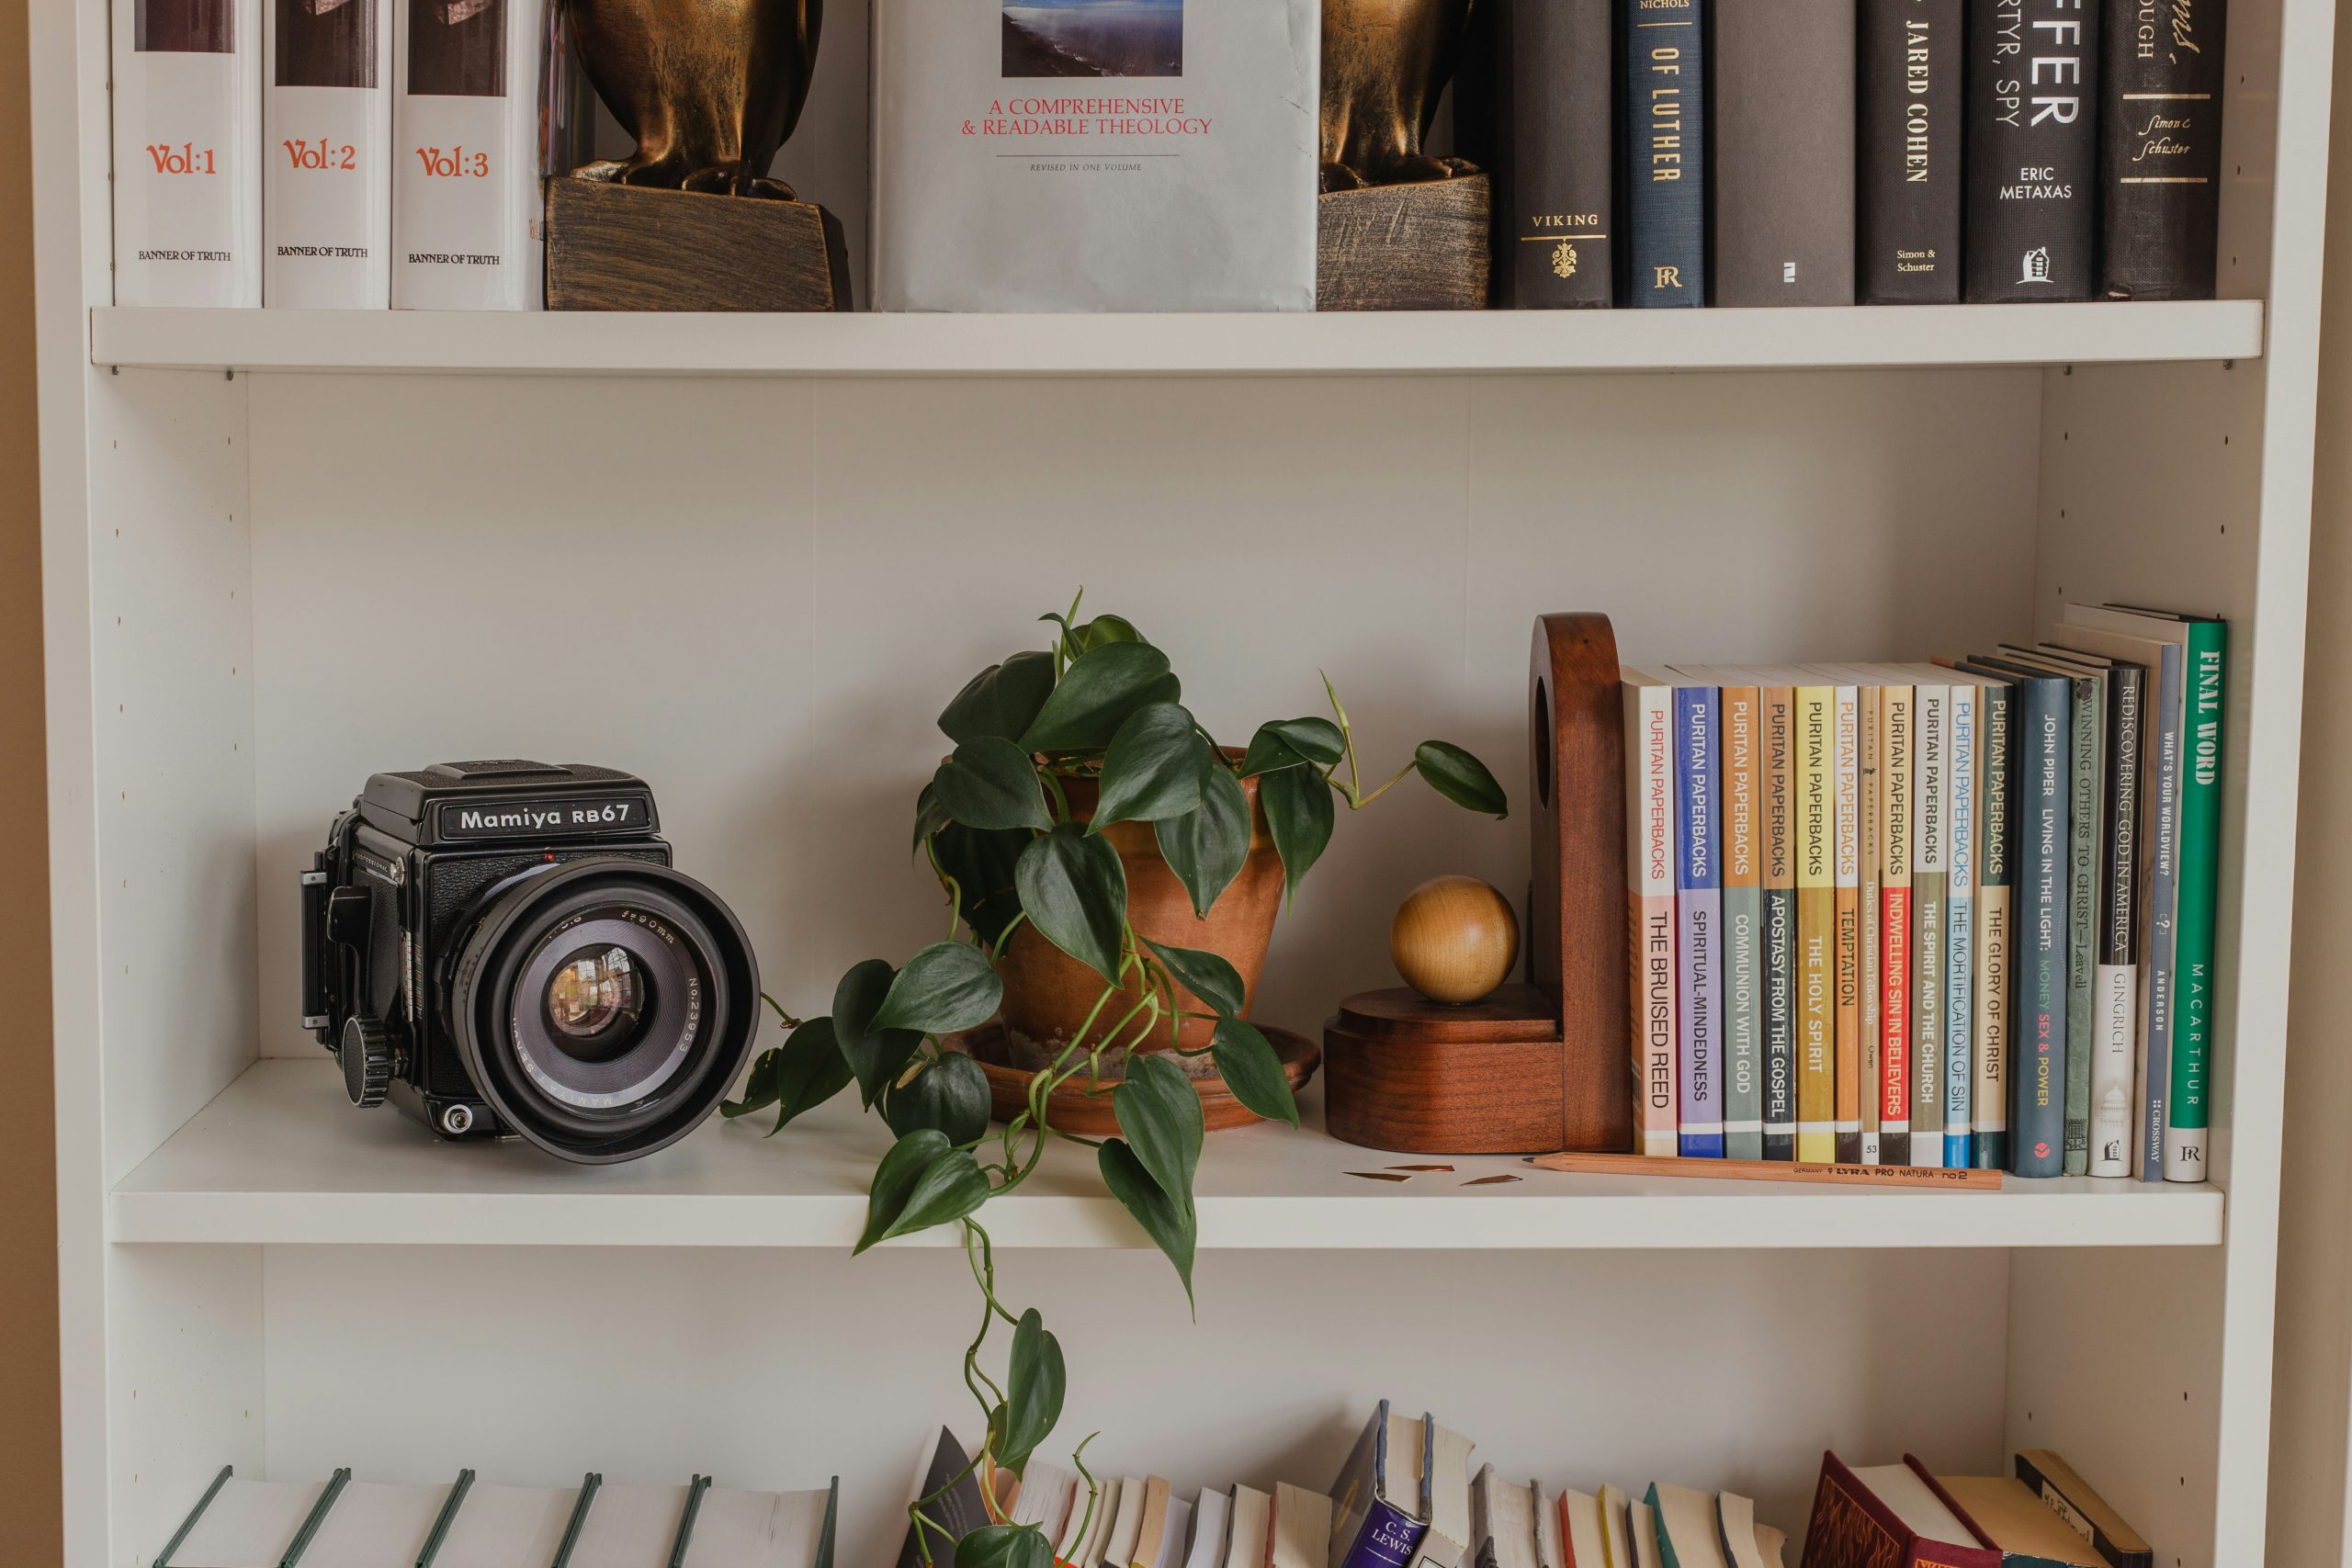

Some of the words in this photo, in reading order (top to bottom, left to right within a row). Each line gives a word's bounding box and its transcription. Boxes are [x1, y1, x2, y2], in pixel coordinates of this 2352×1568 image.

[1640, 0, 1690, 9] NICHOLS
[1652, 48, 1679, 75] OF
[1905, 22, 1929, 94] JARED
[989, 98, 1005, 115] A
[1010, 98, 1185, 116] COMPREHENSIVE
[1996, 80, 2019, 127] SPY
[2138, 114, 2179, 136] Simon
[962, 119, 976, 135] &
[982, 118, 1089, 135] READABLE
[1096, 118, 1212, 136] THEOLOGY
[1652, 88, 1681, 182] LUTHER
[1905, 103, 1928, 184] COHEN
[2132, 137, 2190, 162] Schuster
[146, 141, 216, 175] Vol:1
[283, 138, 356, 171] Vol:2
[415, 145, 489, 178] Vol:3
[1030, 163, 1066, 173] REVISED
[1069, 163, 1080, 173] IN
[1082, 163, 1102, 173] ONE
[1103, 163, 1143, 173] VOLUME
[2020, 167, 2054, 182] ERIC
[1999, 185, 2072, 199] METAXAS
[1532, 214, 1599, 227] VIKING
[138, 250, 180, 263] BANNER
[180, 250, 196, 263] OF
[198, 250, 232, 263] TRUTH
[277, 245, 318, 259] BANNER
[318, 245, 334, 259] OF
[335, 245, 368, 259] TRUTH
[408, 253, 448, 265] BANNER
[450, 253, 465, 265] OF
[467, 253, 500, 265] TRUTH
[1896, 250, 1926, 259] Simon
[1928, 250, 1936, 259] &
[1897, 263, 1935, 272] Schuster
[2198, 650, 2220, 714] FINAL
[1650, 710, 1665, 773] PURITAN
[1691, 704, 1705, 770] PURITAN
[1734, 702, 1747, 768] PURITAN
[1771, 704, 1785, 770] PURITAN
[1808, 702, 1822, 768] PURITAN
[1841, 702, 1854, 768] PURITAN
[1891, 702, 1905, 768] PURITAN
[1927, 698, 1939, 763] PURITAN
[1955, 702, 1970, 773] PURITAN
[1991, 700, 2006, 766] PURITAN
[2043, 715, 2056, 753] JOHN
[2080, 698, 2093, 772] WINNING
[2119, 685, 2135, 811] REDISCOVERING
[2163, 731, 2174, 772] WHAT'S
[2195, 721, 2217, 785] WORD
[2042, 758, 2054, 796] PIPER
[2163, 774, 2173, 803] YOUR
[460, 807, 561, 829] Mamiya
[572, 805, 629, 824] RB67
[1650, 778, 1665, 880] PAPERBACKS
[1691, 774, 1707, 878] PAPERBACKS
[1734, 772, 1749, 875] PAPERBACKS
[1771, 774, 1786, 878] PAPERBACKS
[1808, 773, 1823, 876] PAPERBACKS
[1841, 772, 1854, 875] PAPERBACKS
[1890, 772, 1905, 875] PAPERBACKS
[1926, 766, 1939, 864] PAPERBACKS
[1953, 775, 1970, 887] PAPERBACKS
[1989, 771, 2005, 874] PAPERBACKS
[2041, 808, 2054, 854] LIVING
[2078, 778, 2092, 839] OTHERS
[2078, 845, 2091, 867] TO
[2117, 819, 2131, 856] GOD
[2160, 807, 2172, 876] WORLDVIEW?
[2041, 858, 2052, 873] IN
[2117, 861, 2130, 878] IN
[1866, 882, 1876, 911] Duties
[2041, 876, 2052, 903] THE
[1650, 911, 1668, 953] THE
[1771, 896, 1786, 975] APOSTASY
[1866, 915, 1876, 924] of
[1922, 901, 1937, 929] THE
[1953, 902, 1968, 933] THE
[1988, 908, 2002, 938] THE
[2040, 908, 2051, 952] LIGHT:
[2114, 884, 2129, 952] AMERICA
[1808, 936, 1823, 967] THE
[1841, 908, 1854, 1007] TEMPTATION
[1865, 927, 1876, 972] Christian
[1889, 893, 1903, 986] INDWELLING
[1922, 931, 1936, 976] SPIRIT
[1735, 914, 1749, 1012] COMMUNION
[1988, 942, 2001, 996] GLORY
[2038, 959, 2051, 1010] MONEY
[1650, 957, 1668, 1047] BRUISED
[1692, 911, 1707, 1101] SPIRITUAL-MINDEDNESS
[1771, 979, 1785, 1021] FROM
[1808, 972, 1823, 1014] HOLY
[1865, 974, 1876, 1025] Fellowship
[1888, 989, 1902, 1014] SIN
[1922, 980, 1935, 1010] AND
[1951, 937, 1967, 1056] MORTIFICATION
[1988, 999, 2000, 1021] OF
[2111, 973, 2126, 1053] GINGRICH
[2155, 970, 2165, 1031] ANDERSON
[1736, 1016, 1749, 1056] WITH
[1771, 1023, 1785, 1055] THE
[1808, 1021, 1823, 1073] SPIRIT
[1888, 1018, 1902, 1033] IN
[1921, 1012, 1935, 1040] THE
[2038, 1014, 2050, 1038] SEX
[2038, 1043, 2049, 1053] &
[2187, 964, 2204, 1105] MACARTHUR
[1887, 1037, 1902, 1115] BELIEVERS
[1921, 1043, 1935, 1103] CHURCH
[1951, 1060, 1966, 1081] OF
[1986, 1025, 2000, 1082] CHRIST
[1652, 1053, 1668, 1109] REED
[1736, 1060, 1750, 1094] GOD
[1771, 1058, 1786, 1117] GOSPEL
[1951, 1086, 1966, 1111] SIN
[2038, 1056, 2049, 1106] POWER
[1867, 1145, 1877, 1154] 53
[2151, 1110, 2161, 1163] CROSSWAY
[1875, 1168, 1894, 1177] PRO
[1899, 1169, 1934, 1178] NATURA
[1371, 1529, 1414, 1556] LEWIS
[1385, 1521, 1396, 1535] C.
[1400, 1529, 1411, 1541] S.
